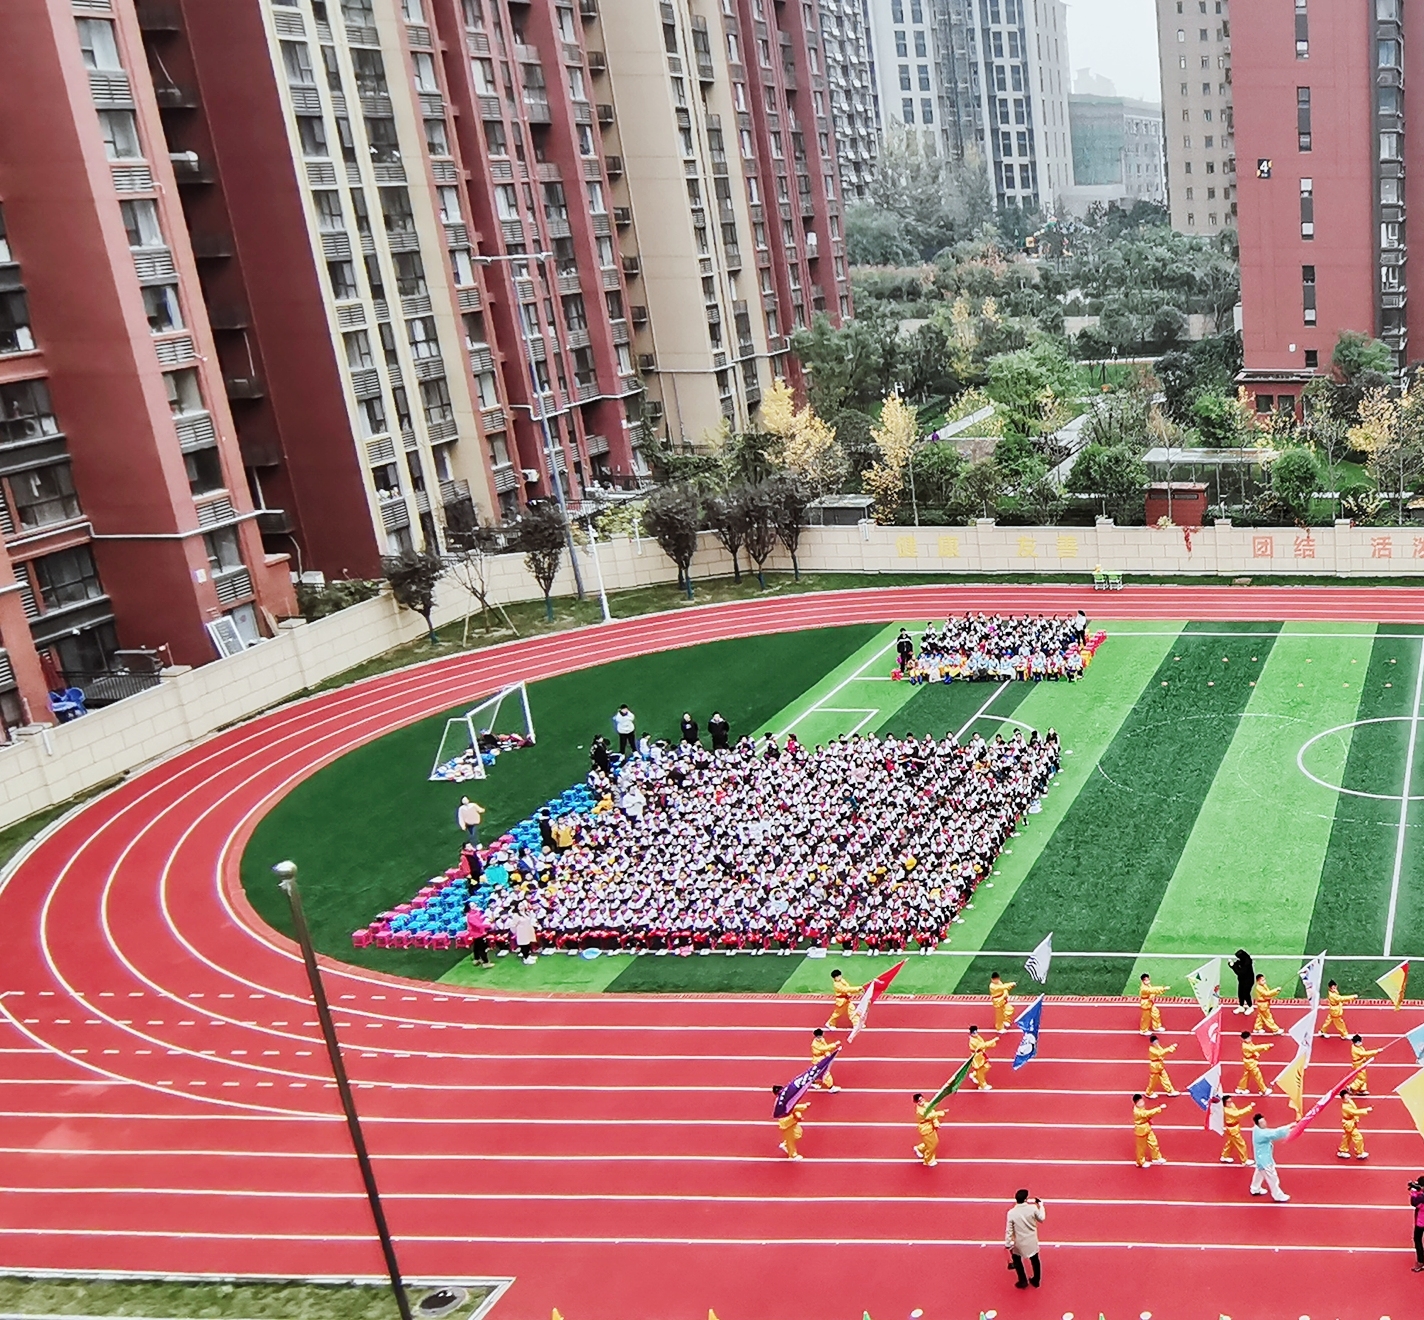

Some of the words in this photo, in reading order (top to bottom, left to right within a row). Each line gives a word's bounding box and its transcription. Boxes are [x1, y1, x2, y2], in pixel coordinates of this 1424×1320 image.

[1260, 160, 1269, 173] 4
[896, 535, 960, 558] 健康
[1016, 536, 1079, 558] 友善
[1252, 536, 1316, 559] 团结
